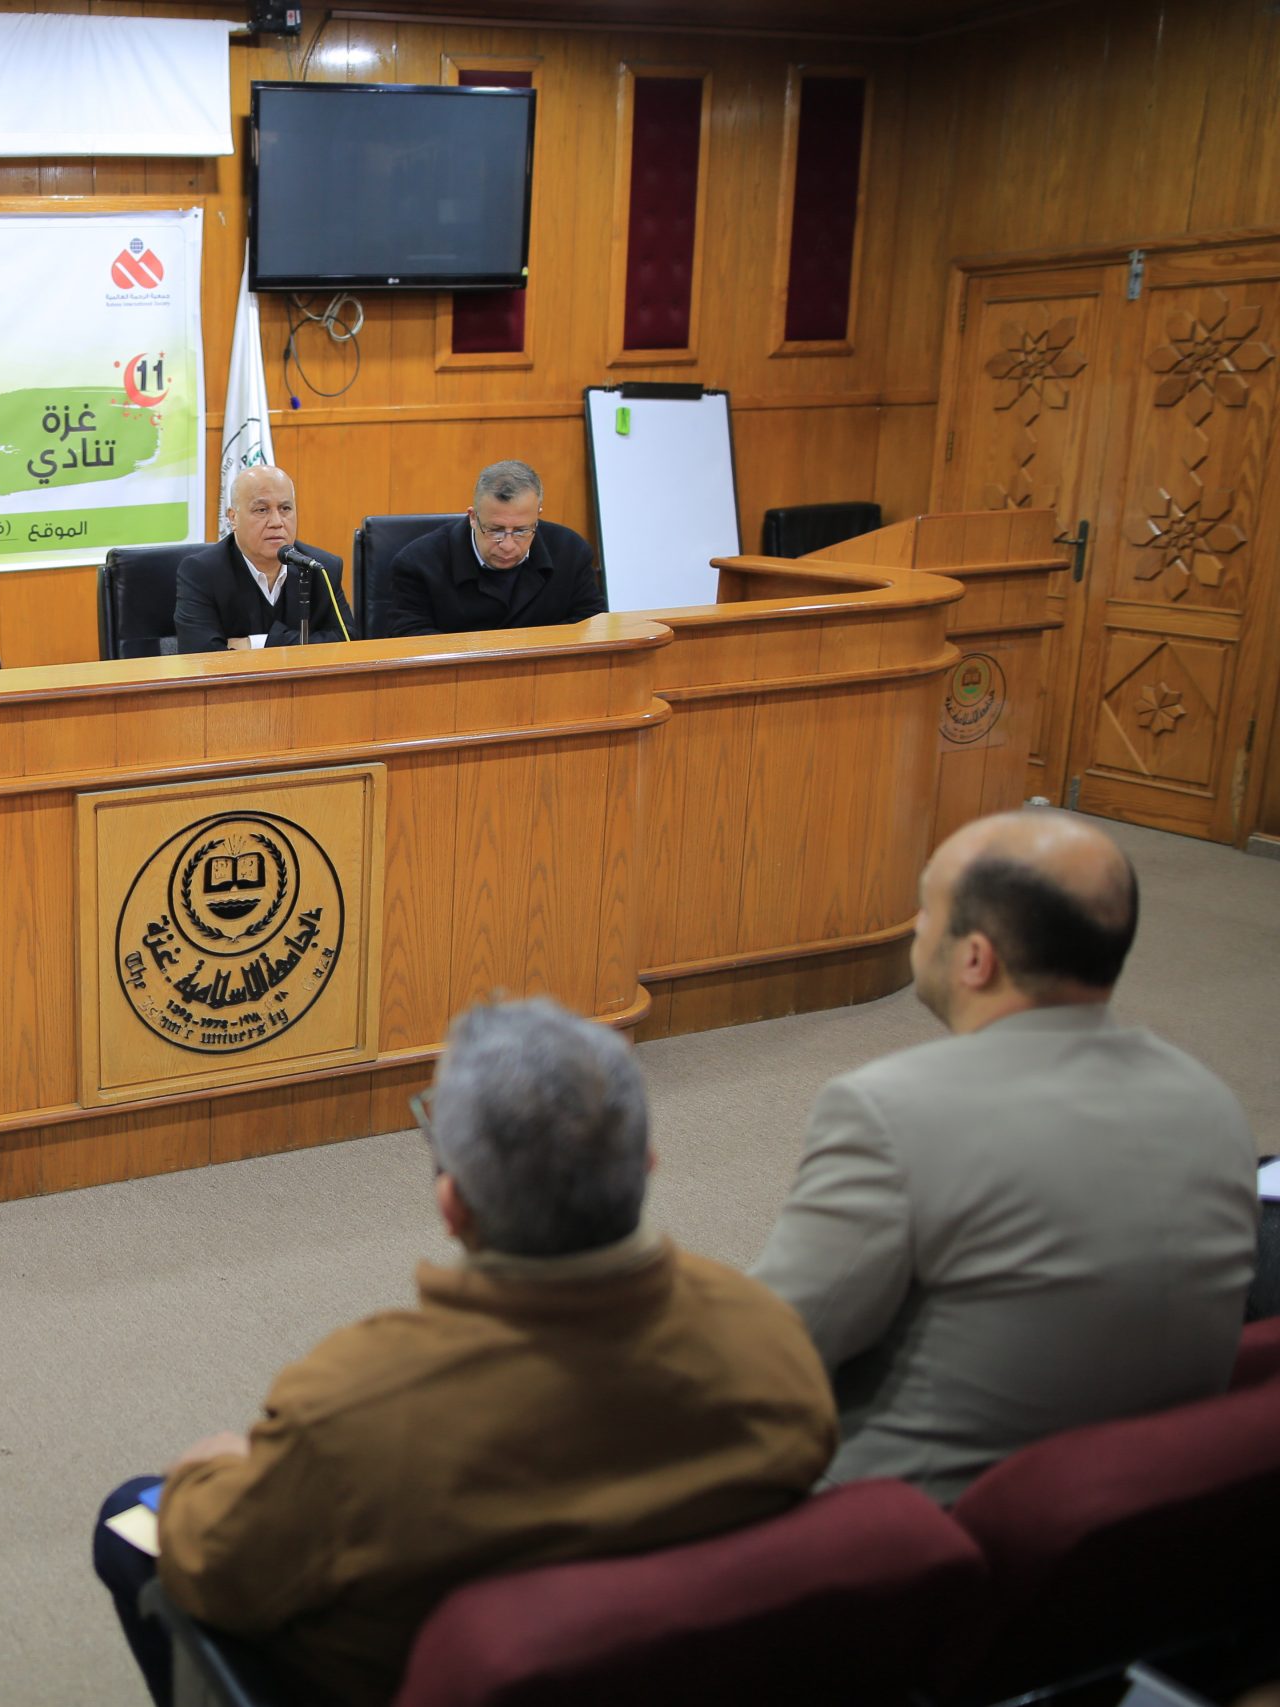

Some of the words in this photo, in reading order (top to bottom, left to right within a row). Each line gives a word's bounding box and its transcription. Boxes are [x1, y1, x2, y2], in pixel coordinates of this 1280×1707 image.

[136, 360, 164, 391] 11
[41, 403, 97, 441] غزة
[26, 437, 116, 484] تنادي
[27, 521, 88, 542] الموقع
